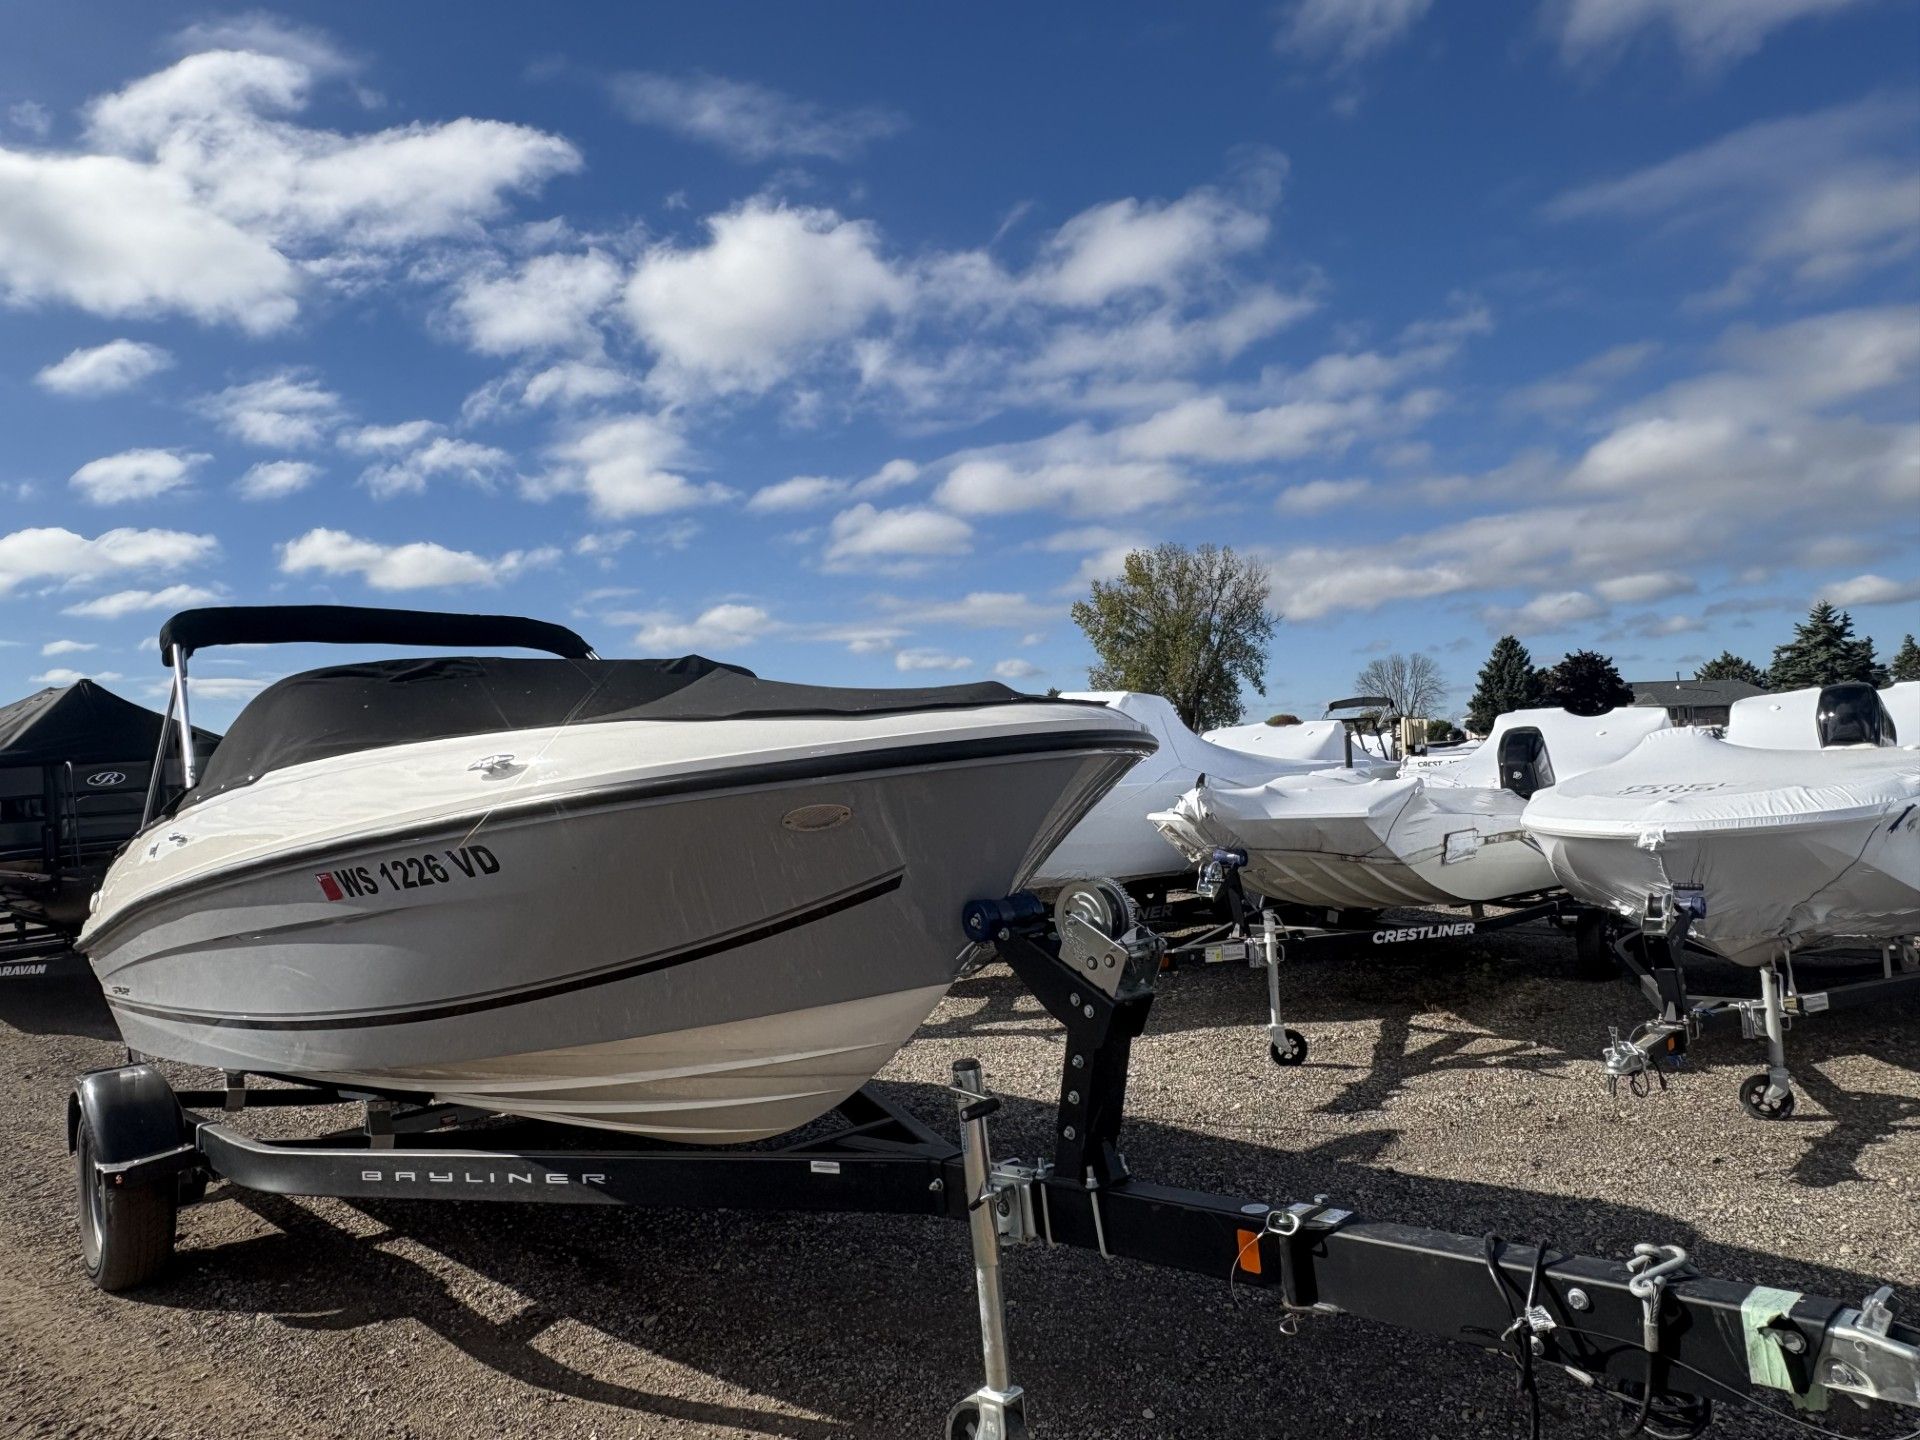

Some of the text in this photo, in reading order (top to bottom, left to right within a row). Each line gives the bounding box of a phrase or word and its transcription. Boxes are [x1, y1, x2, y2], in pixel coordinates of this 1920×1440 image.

[334, 845, 500, 898] WS 1226 VD
[1372, 922, 1475, 944] CRESTLINER
[0, 964, 47, 977] RAVAN
[361, 1170, 606, 1185] BAYLINER
